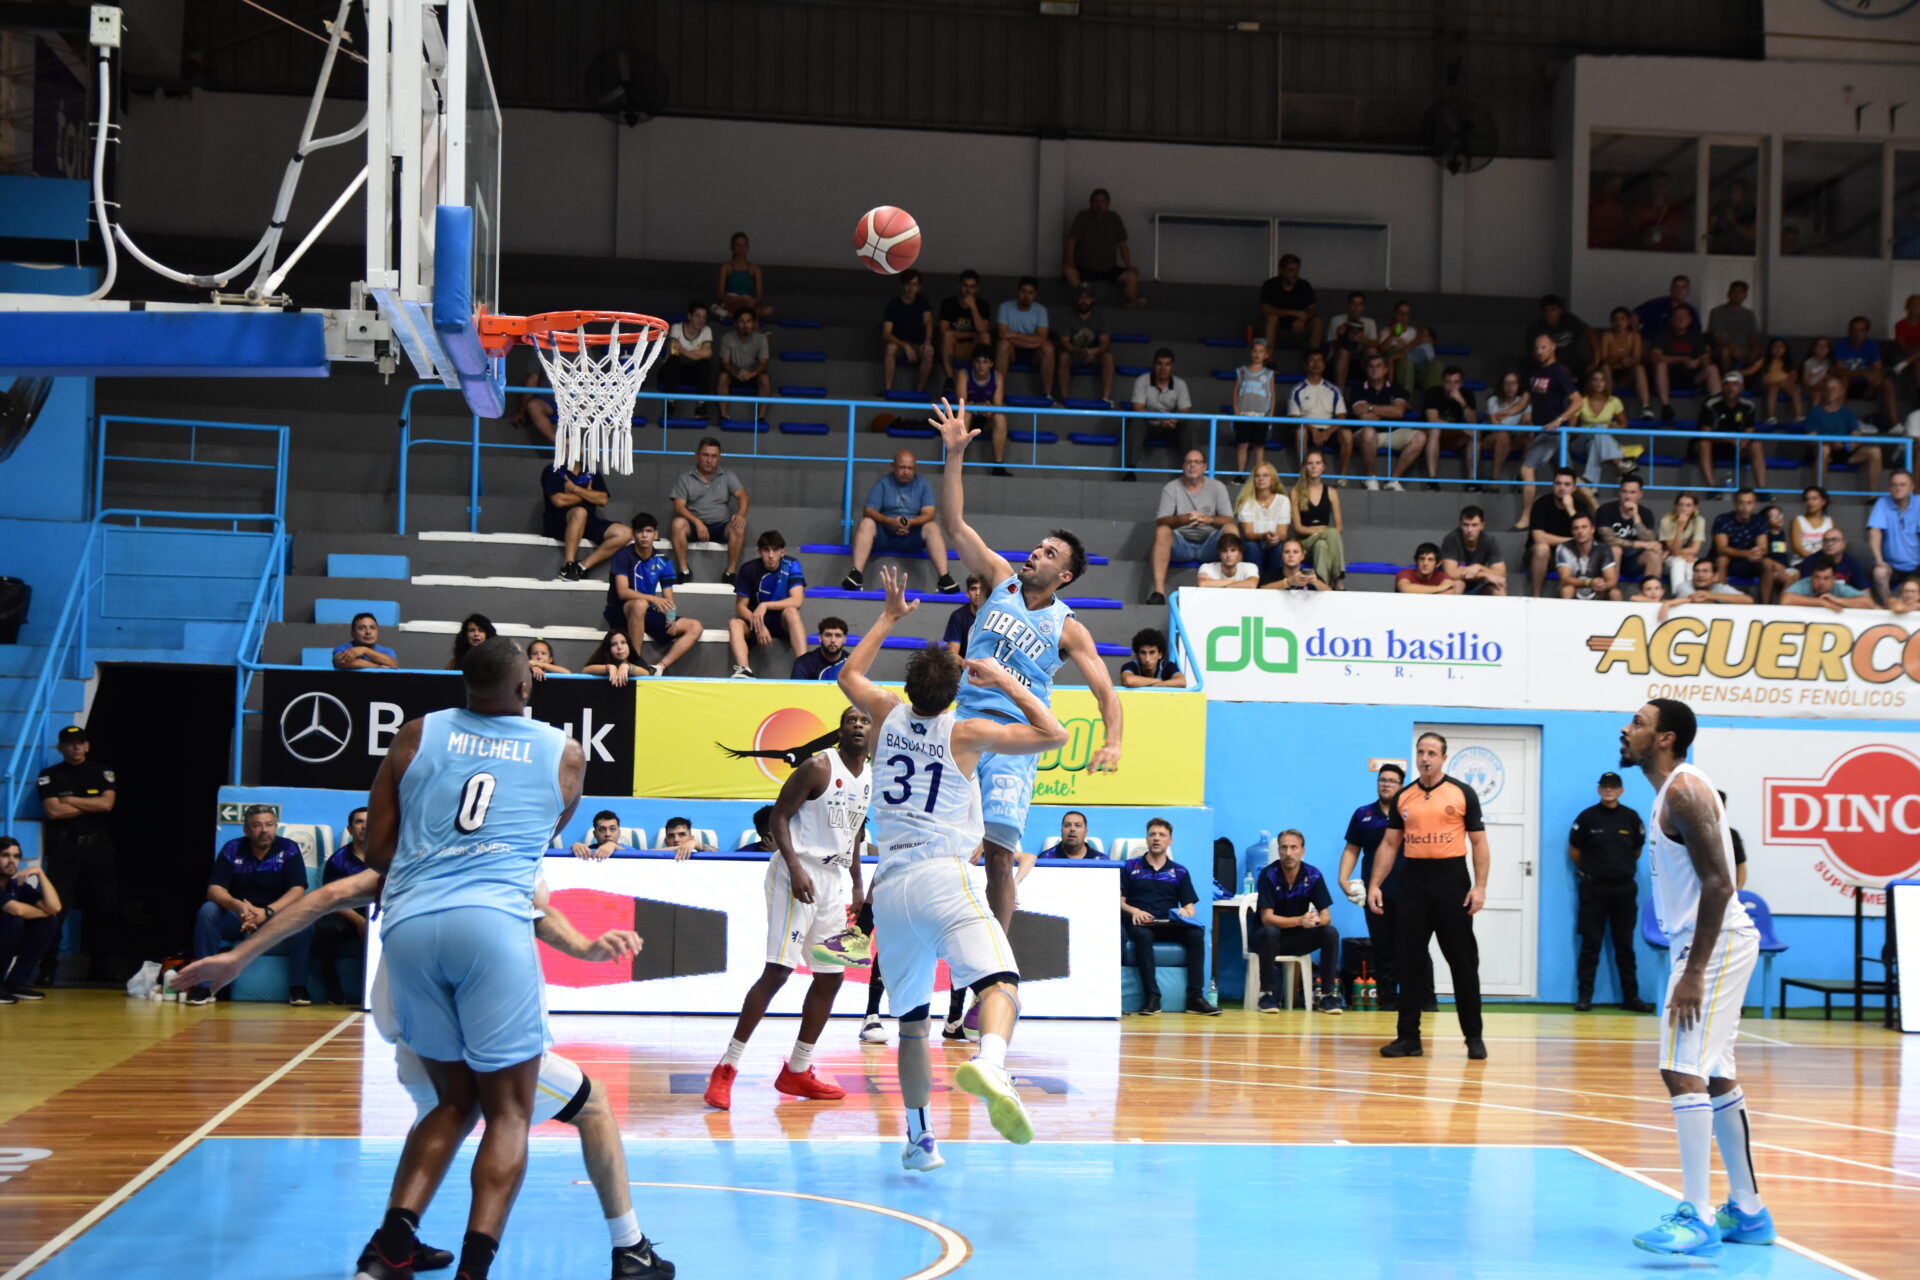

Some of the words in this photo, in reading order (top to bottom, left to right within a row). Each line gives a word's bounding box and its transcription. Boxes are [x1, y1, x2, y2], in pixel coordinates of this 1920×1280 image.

[993, 639, 1017, 663] 17
[1305, 627, 1374, 657] don
[1386, 629, 1503, 662] basilio
[1647, 683, 1793, 704] COMPENSADOS
[1799, 685, 1906, 707] FENÓLICOS
[447, 731, 533, 764] MITCHELL
[886, 733, 944, 759] BASUALDO
[882, 754, 944, 814] 31
[454, 772, 497, 835] 0
